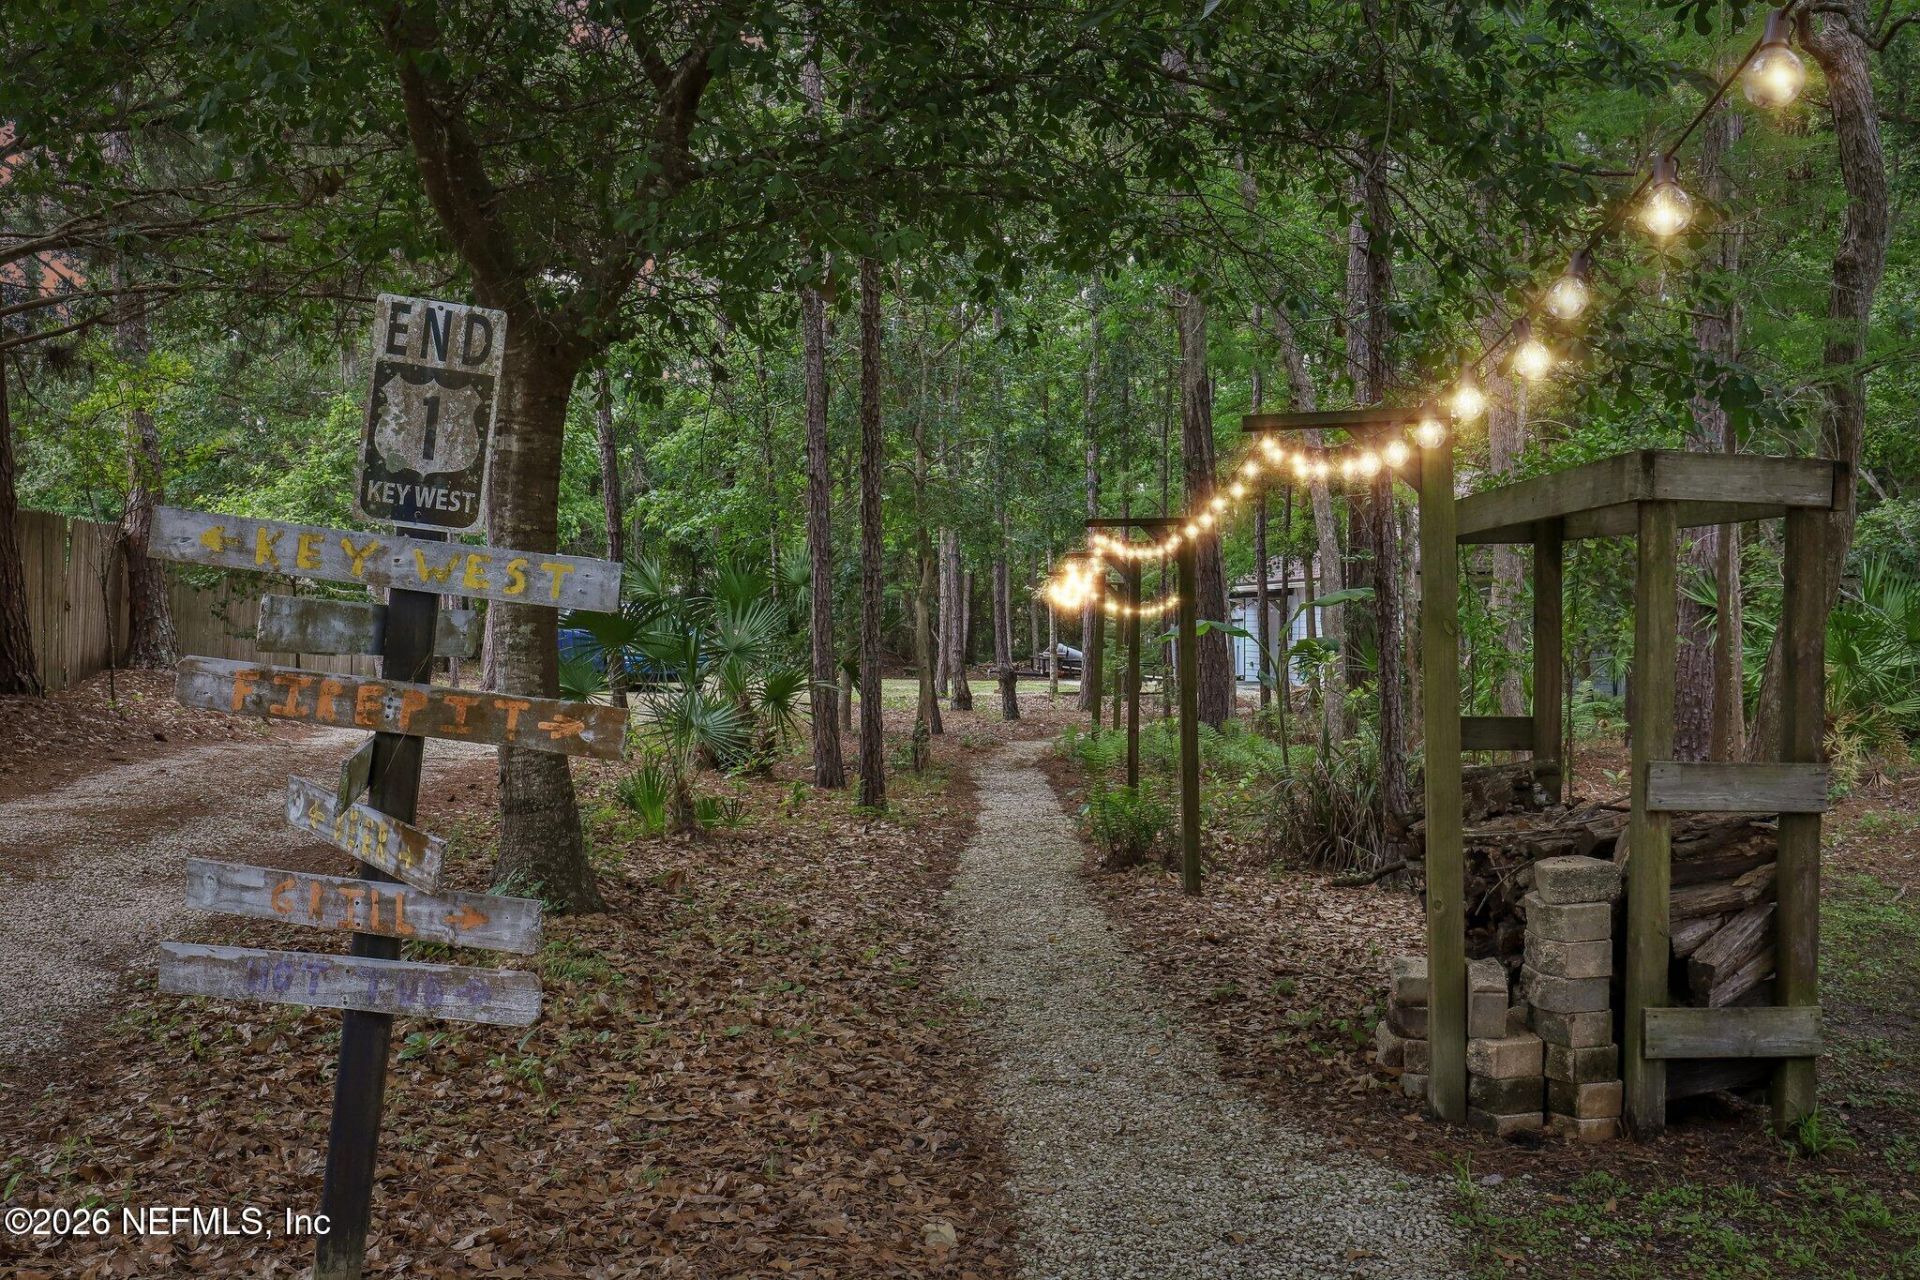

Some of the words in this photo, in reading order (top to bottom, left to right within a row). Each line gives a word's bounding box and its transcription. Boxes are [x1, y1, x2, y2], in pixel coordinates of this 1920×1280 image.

[386, 301, 493, 367] END
[423, 396, 441, 460] 1
[367, 480, 411, 505] KEY
[415, 486, 475, 513] WEST
[255, 527, 381, 576] KEY
[413, 547, 575, 599] WEST
[271, 877, 416, 935] GRILL
[245, 959, 329, 996] HOT
